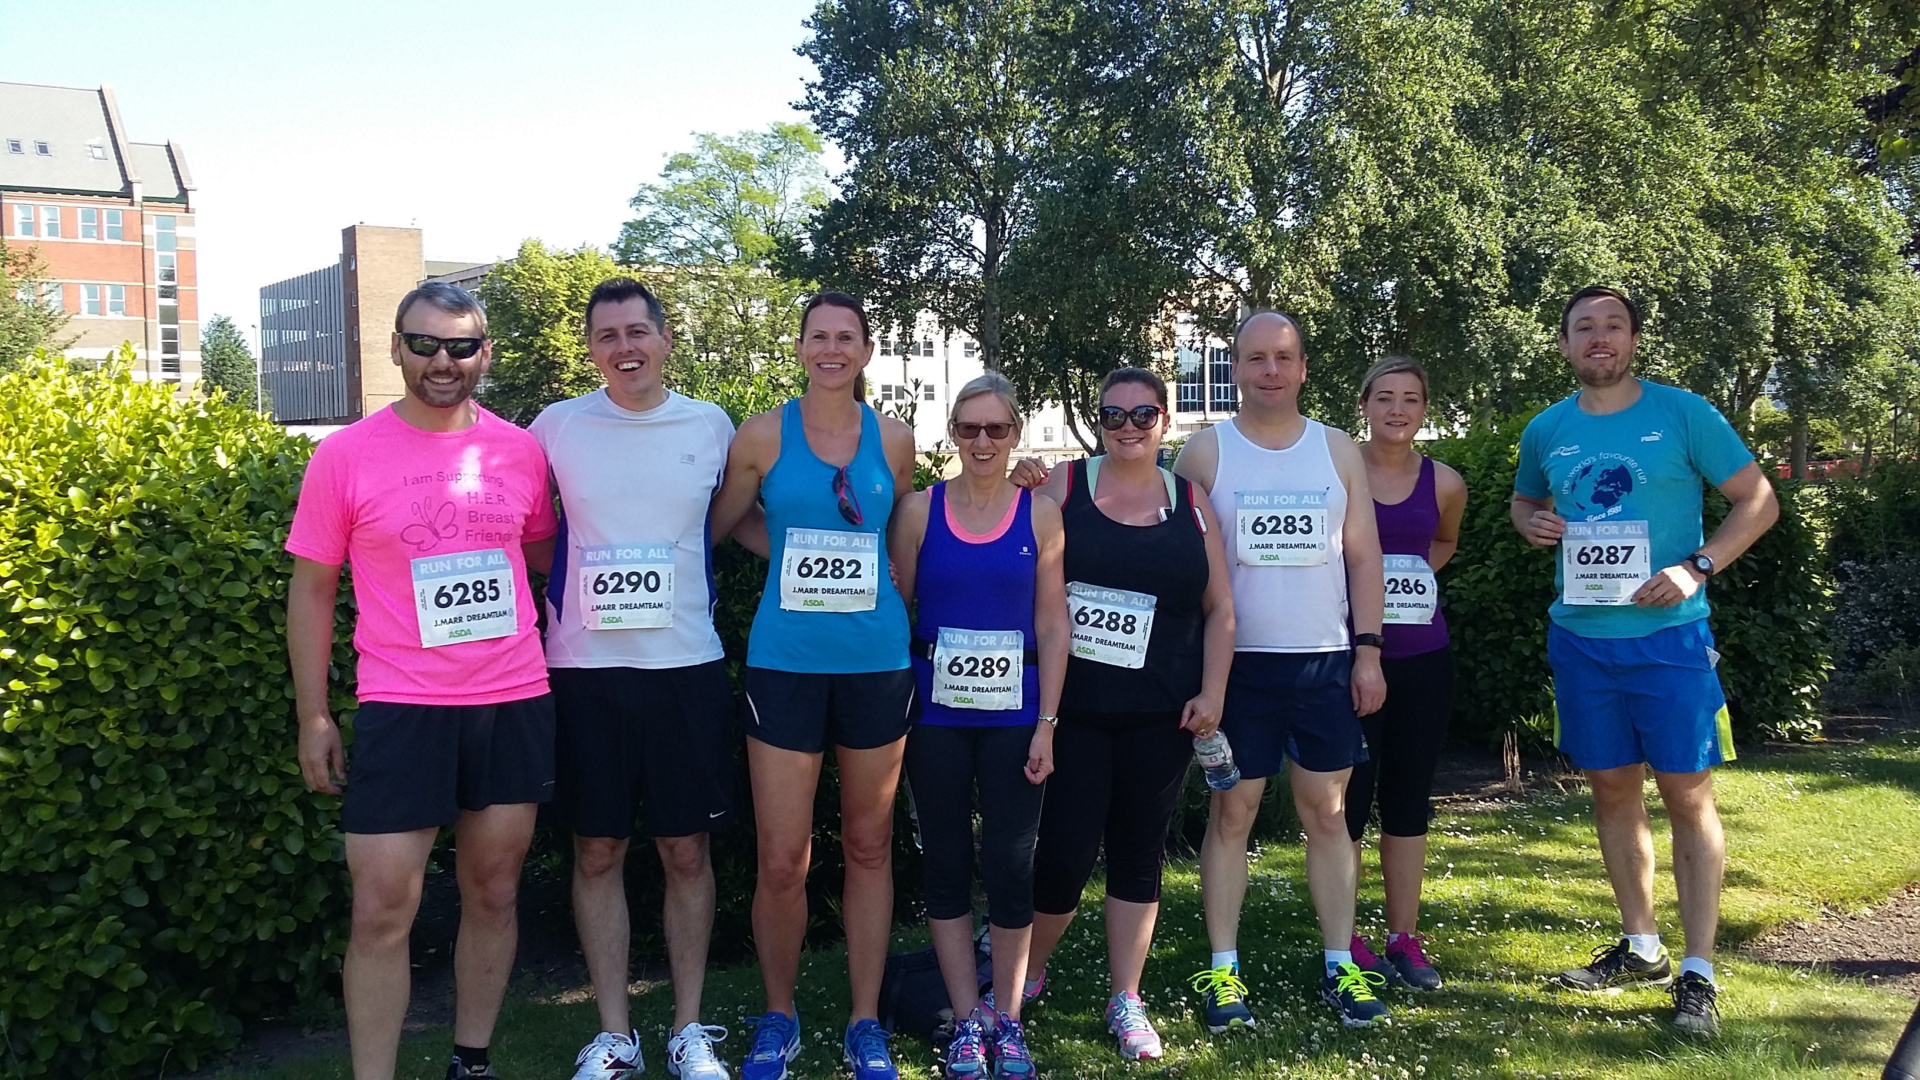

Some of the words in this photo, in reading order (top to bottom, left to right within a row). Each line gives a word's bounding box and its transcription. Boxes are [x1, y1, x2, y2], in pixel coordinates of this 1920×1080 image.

[411, 475, 433, 486] am
[1562, 480, 1570, 495] the
[1599, 452, 1638, 469] favourite
[1635, 468, 1647, 484] run
[1243, 495, 1269, 505] RUN
[1273, 495, 1297, 504] FOR
[1301, 495, 1321, 504] ALL
[468, 511, 516, 525] Breast
[1251, 515, 1313, 535] 6283
[1567, 526, 1592, 536] RUN
[1596, 526, 1619, 535] FOR
[1623, 525, 1643, 534] ALL
[793, 533, 818, 545] RUN
[823, 535, 847, 547] FOR
[851, 537, 872, 548] ALL
[586, 550, 611, 562] RUN
[616, 548, 642, 560] FOR
[647, 548, 669, 559] ALL
[1577, 545, 1636, 565] 6287
[420, 560, 452, 575] RUN
[456, 556, 483, 569] FOR
[487, 554, 506, 566] ALL
[797, 556, 862, 579] 6282
[1392, 558, 1412, 568] FOR
[593, 570, 661, 595] 6290
[1384, 577, 1427, 595] 286
[434, 578, 500, 609] 6285
[792, 586, 819, 594] J.MARR
[1071, 584, 1098, 598] RUN
[1102, 590, 1126, 603] FOR
[1130, 596, 1150, 607] ALL
[619, 602, 664, 611] DREAMTEAM
[802, 599, 825, 607] ASDA
[434, 616, 464, 627] J.MARR
[466, 609, 508, 622] DREAMTEAM
[601, 616, 623, 624] ASDA
[1074, 605, 1137, 635] 6288
[449, 628, 472, 639] ASDA
[943, 632, 968, 645] RUN
[973, 635, 997, 646] FOR
[1001, 635, 1018, 645] ALL
[1075, 645, 1097, 656] ASDA
[1094, 637, 1136, 652] DREAMTEAM
[947, 655, 1011, 678] 6289
[943, 683, 969, 693] J.MARR
[953, 696, 974, 704] ASDA
